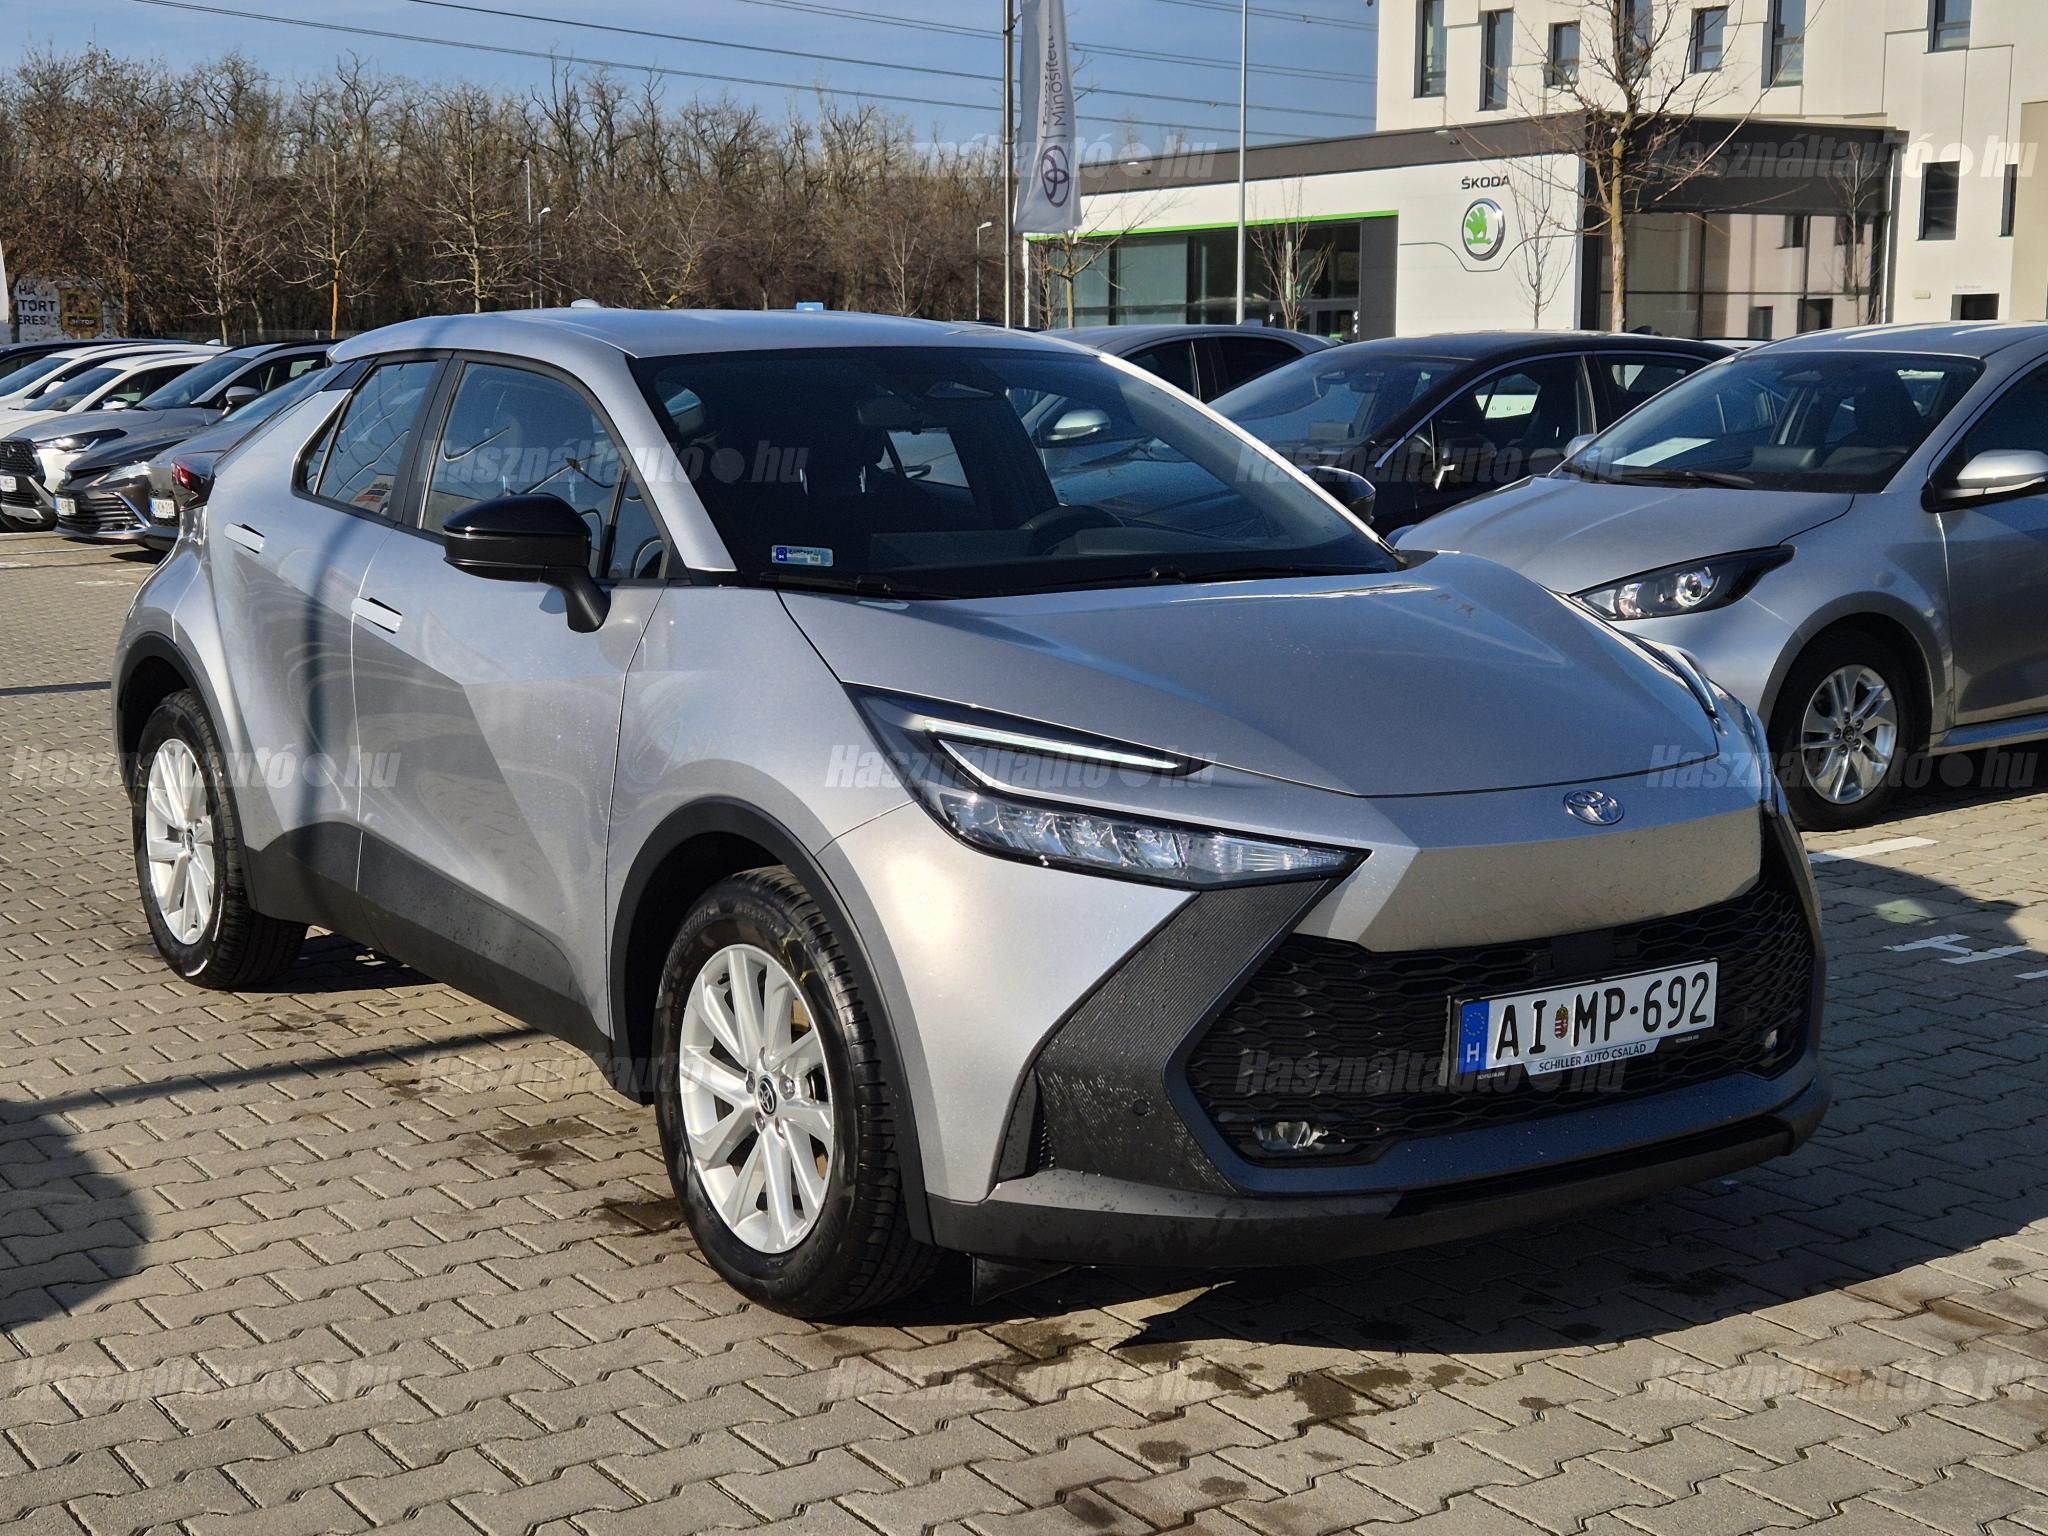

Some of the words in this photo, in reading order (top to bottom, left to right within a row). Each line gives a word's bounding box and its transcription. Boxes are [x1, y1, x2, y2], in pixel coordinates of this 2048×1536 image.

[1461, 176, 1511, 190] ŠKODA
[1494, 1000, 1547, 1061] AI
[1466, 1042, 1480, 1063] H
[1538, 1056, 1582, 1072] SCHILLER
[1584, 1047, 1610, 1064] AUTÓ
[1611, 1041, 1647, 1059] CSALÁD
